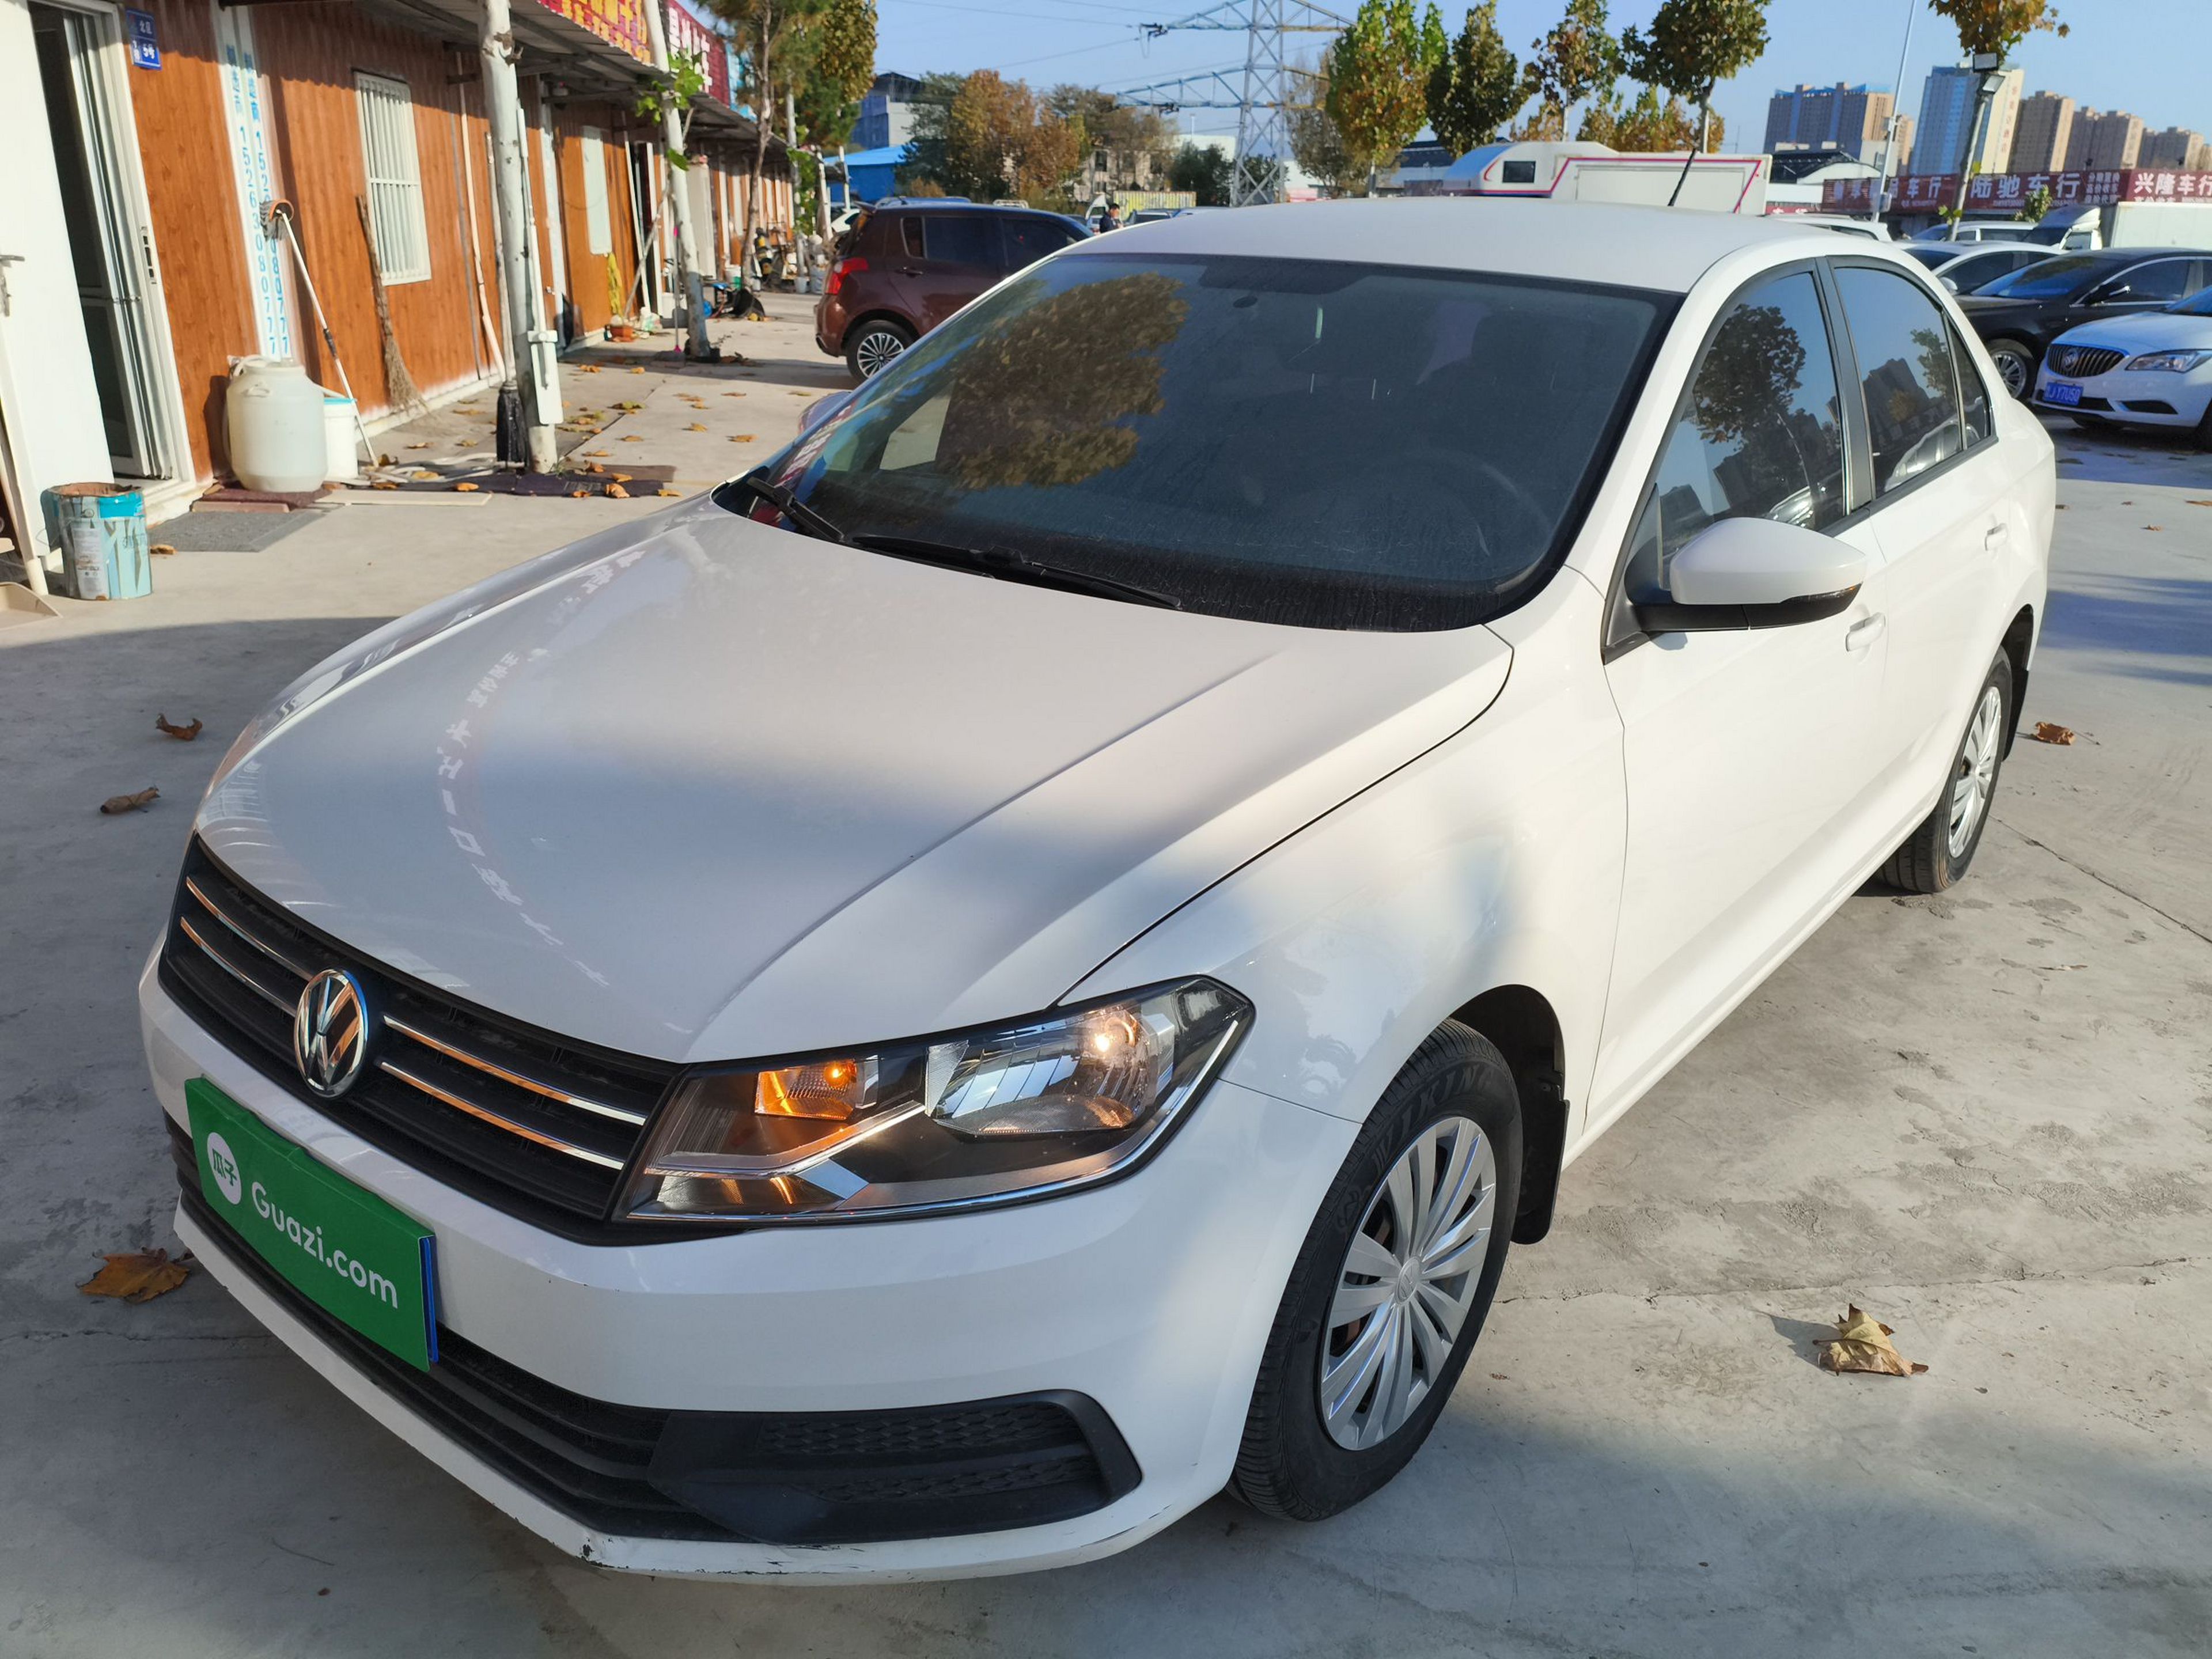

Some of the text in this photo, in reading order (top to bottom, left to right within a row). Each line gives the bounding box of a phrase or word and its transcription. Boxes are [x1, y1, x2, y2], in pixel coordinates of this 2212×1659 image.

[1971, 173, 2081, 199] 陆驰车行
[2134, 172, 2212, 196] 兴隆车行
[256, 131, 287, 354] 152080777
[251, 1181, 398, 1309] Guazi.com
